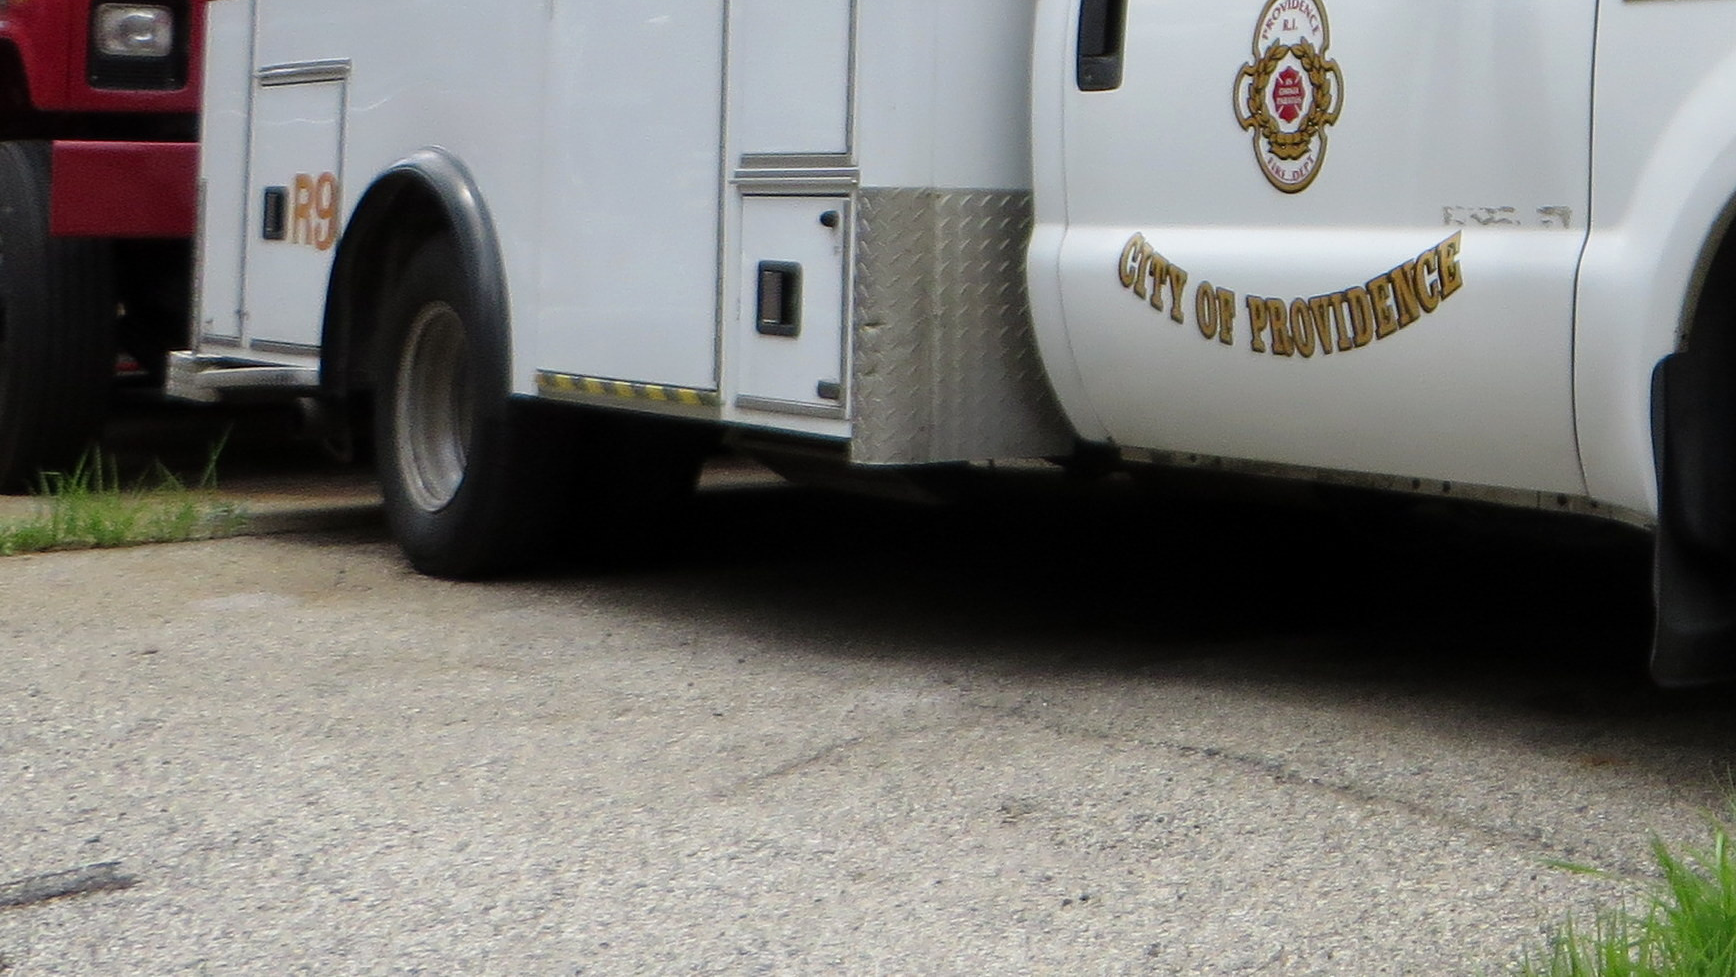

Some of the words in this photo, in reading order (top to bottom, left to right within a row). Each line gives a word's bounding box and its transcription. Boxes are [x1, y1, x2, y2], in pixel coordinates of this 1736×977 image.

[294, 172, 337, 250] R9
[1118, 232, 1188, 324] CITY
[1196, 280, 1236, 346] OF
[1247, 229, 1464, 358] PROVIDENCE
